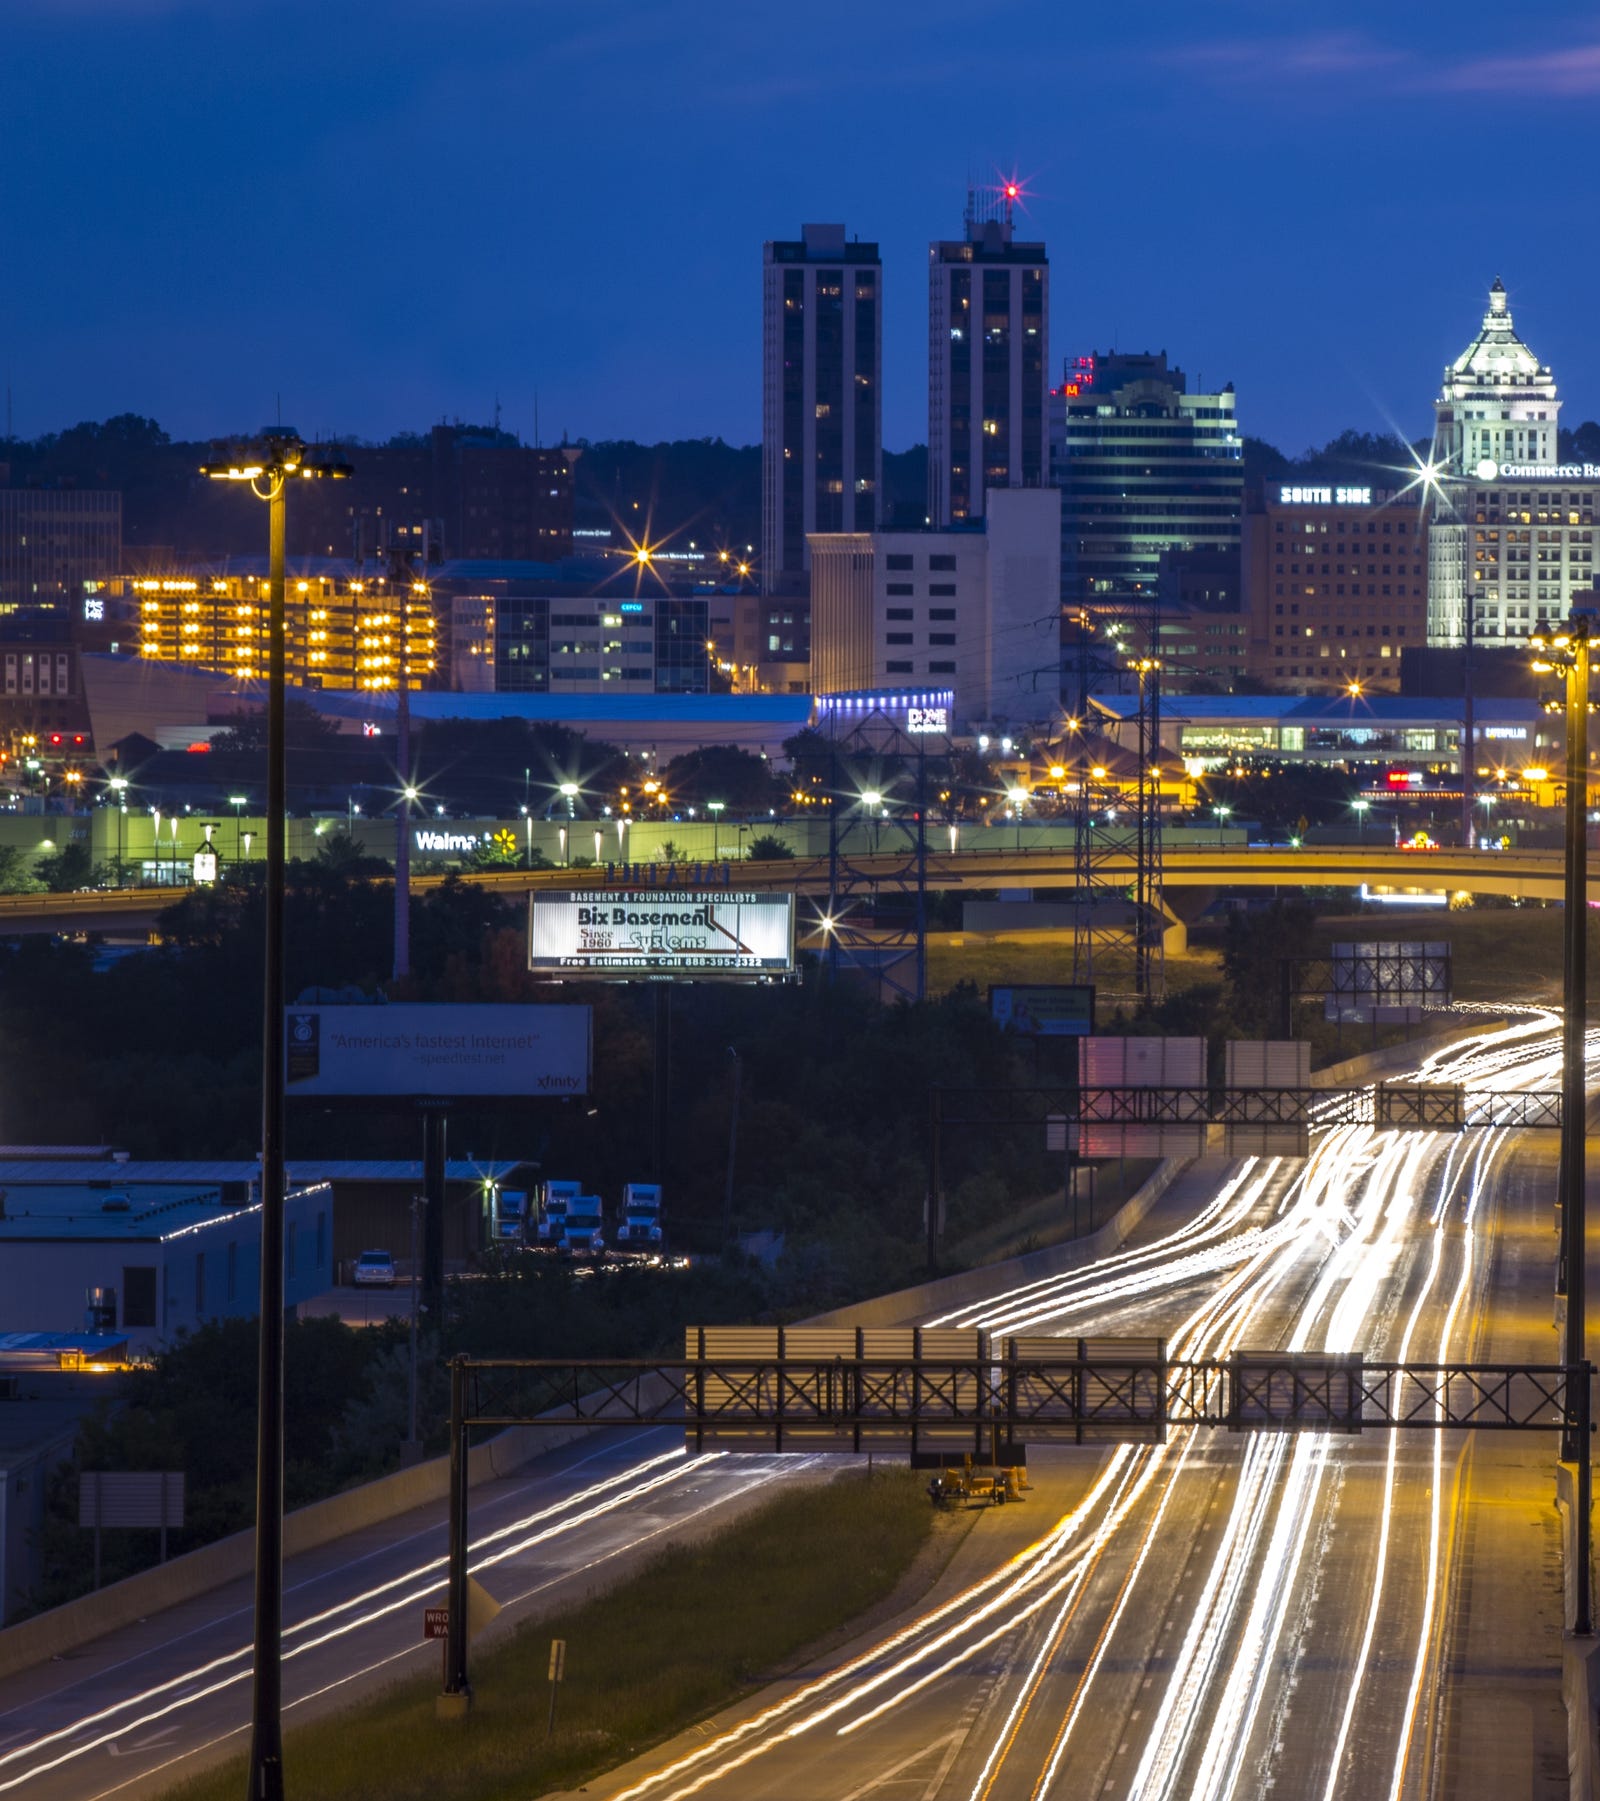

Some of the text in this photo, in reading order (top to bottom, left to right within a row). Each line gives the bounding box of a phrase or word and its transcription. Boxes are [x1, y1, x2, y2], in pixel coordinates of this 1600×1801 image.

[1500, 463, 1582, 477] Commerce
[1281, 487, 1331, 503] SOUTH
[1336, 487, 1371, 503] SIDE
[570, 893, 619, 902] BASEMENT
[633, 893, 692, 902] FOUNDATION
[695, 893, 757, 903] SPECIALISTS
[578, 905, 713, 928] Bix Basement
[580, 929, 613, 938] Since
[582, 938, 611, 947] 1960
[619, 927, 706, 953] Systems
[559, 957, 585, 966] Free
[589, 957, 647, 966] Estimates
[658, 958, 681, 967] Call
[685, 958, 762, 967] 888-395-2322
[416, 1034, 466, 1049] fastest
[537, 1075, 580, 1088] xfinity
[426, 1612, 449, 1623] WRO
[433, 1625, 449, 1635] WA
